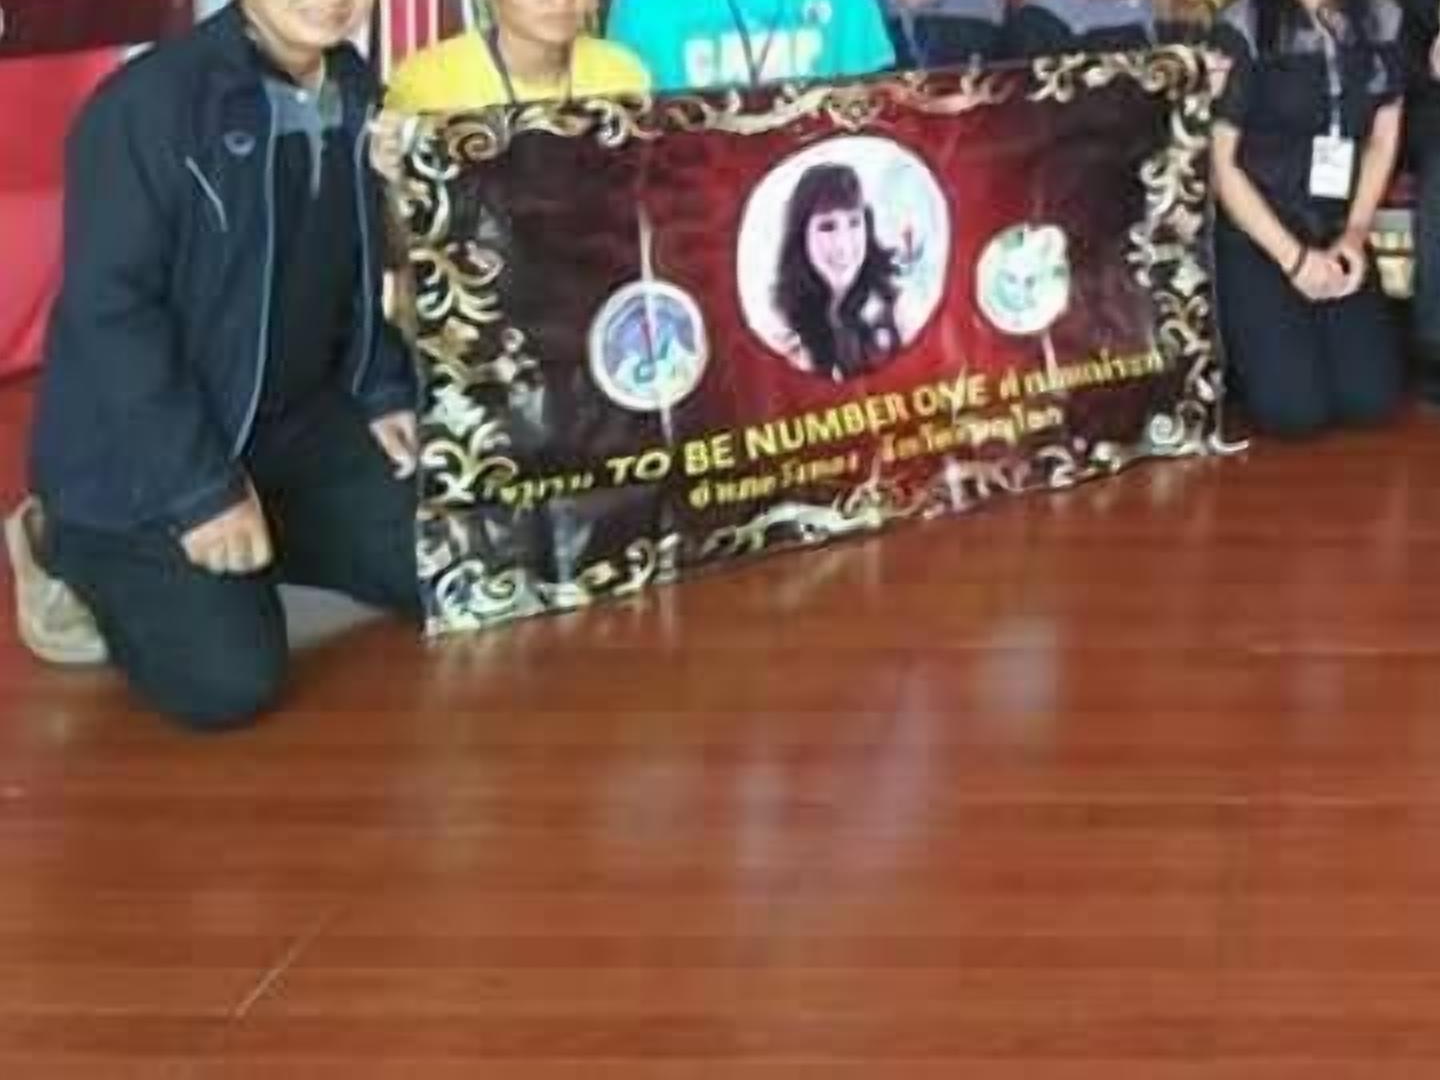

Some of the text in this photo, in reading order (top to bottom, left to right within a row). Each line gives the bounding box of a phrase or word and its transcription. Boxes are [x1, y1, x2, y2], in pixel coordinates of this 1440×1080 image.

[606, 447, 672, 484] TO
[683, 433, 738, 476] BE
[744, 390, 910, 458] NUMBER
